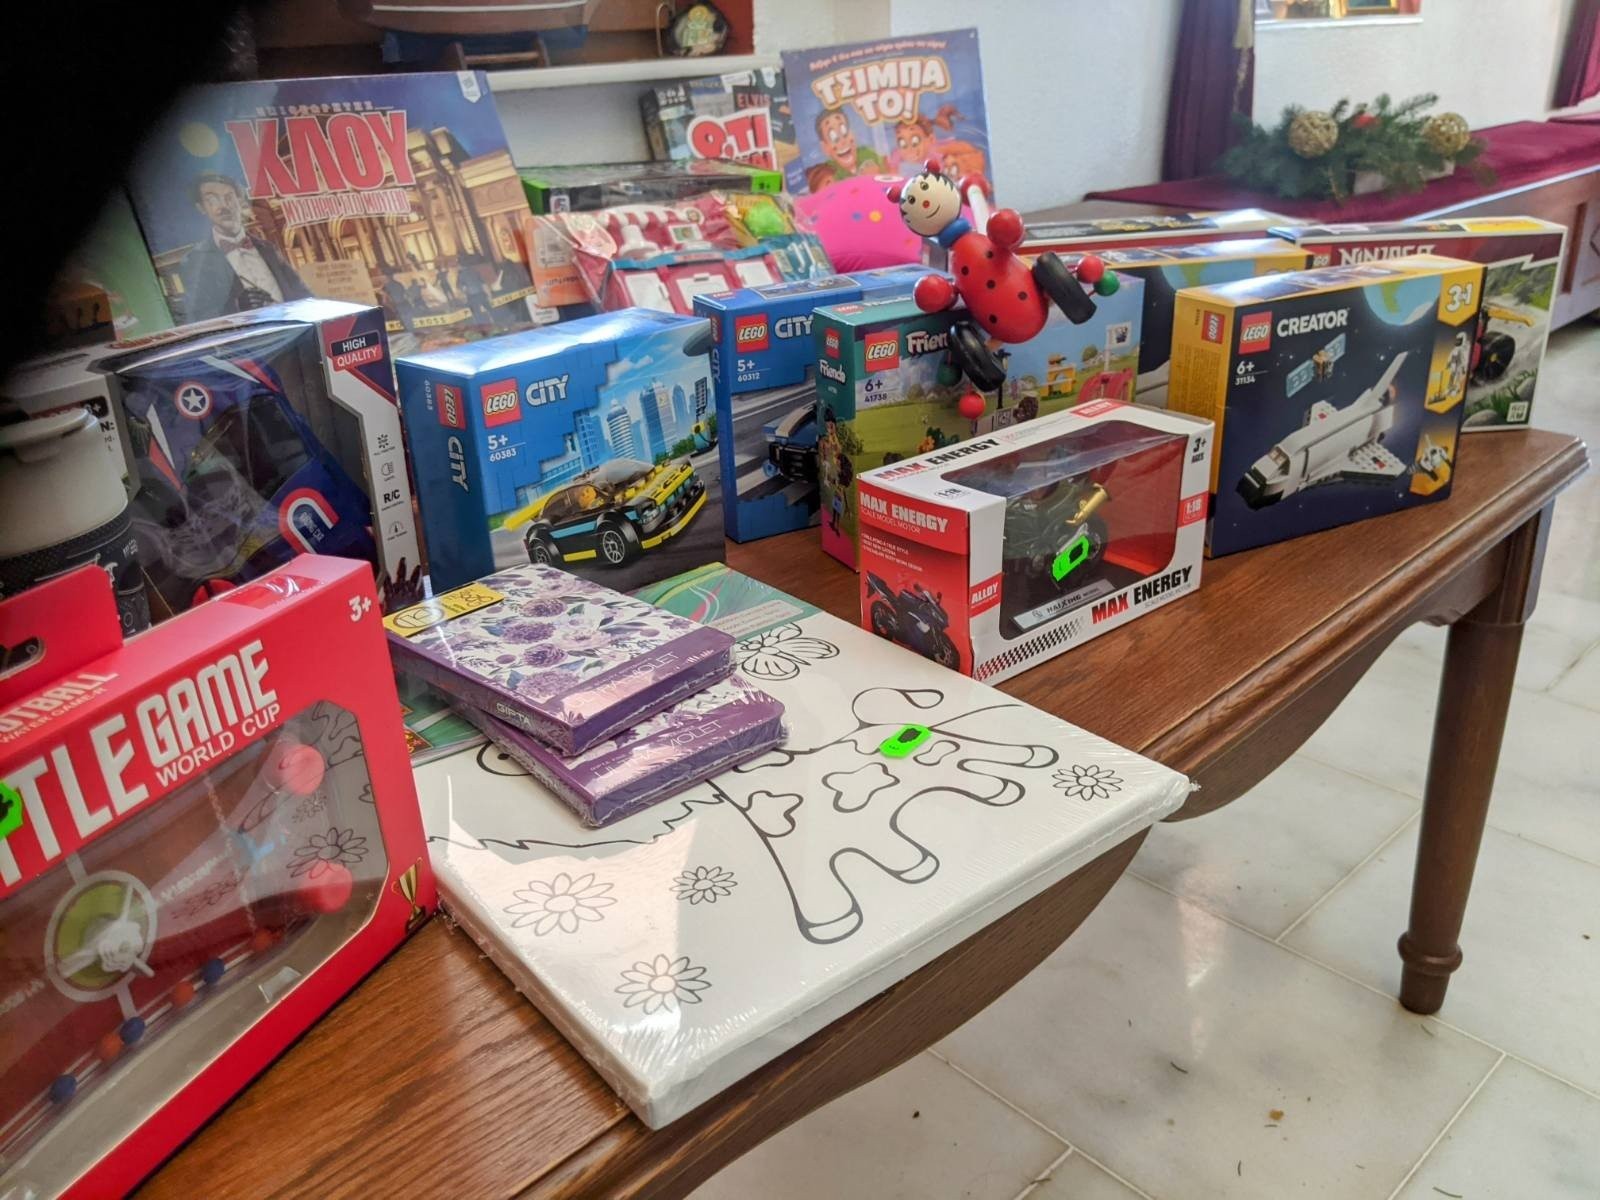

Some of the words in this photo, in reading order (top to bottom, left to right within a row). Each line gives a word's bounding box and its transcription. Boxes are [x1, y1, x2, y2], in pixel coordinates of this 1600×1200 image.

[814, 59, 946, 104] ΤΣΙΜΠΑ
[856, 89, 915, 121] ΤΟ!
[225, 110, 416, 199] ΚΛΟΥ
[738, 324, 767, 342] LEGO
[774, 314, 814, 339] CITY
[1242, 323, 1270, 342] LEGO
[1276, 308, 1349, 338] CREATOR
[337, 346, 378, 367] QUALITY
[342, 336, 367, 352] HIGH
[867, 341, 897, 360] LEGO
[906, 330, 949, 354] Frien
[737, 359, 756, 372] 5+
[737, 372, 761, 382] 60312
[1236, 360, 1255, 375] 6+
[864, 379, 883, 392] 6+
[1234, 375, 1256, 386] 31134
[442, 385, 458, 426] LEGO
[485, 391, 518, 415] LEGO
[525, 374, 570, 407] CITY
[864, 393, 887, 402] 41738
[487, 434, 509, 451] 5+
[489, 447, 517, 462] 60383
[1192, 437, 1207, 453] 3+
[447, 435, 470, 492] CITY
[873, 463, 928, 482] MAX
[927, 437, 1001, 466] ENERGY
[383, 488, 401, 503] R/C
[859, 491, 888, 515] MAX
[891, 504, 949, 533] ENERGY
[898, 520, 921, 534] MOTOR
[970, 582, 999, 604] ALLOY
[1091, 592, 1129, 625] MAX
[1133, 565, 1193, 605] ENERGY
[348, 595, 372, 622] 3+
[630, 651, 680, 677] IOLET
[136, 639, 279, 770] GAME
[495, 701, 531, 726] GIPTA
[155, 730, 236, 788] WORLD
[241, 703, 282, 738] CUP
